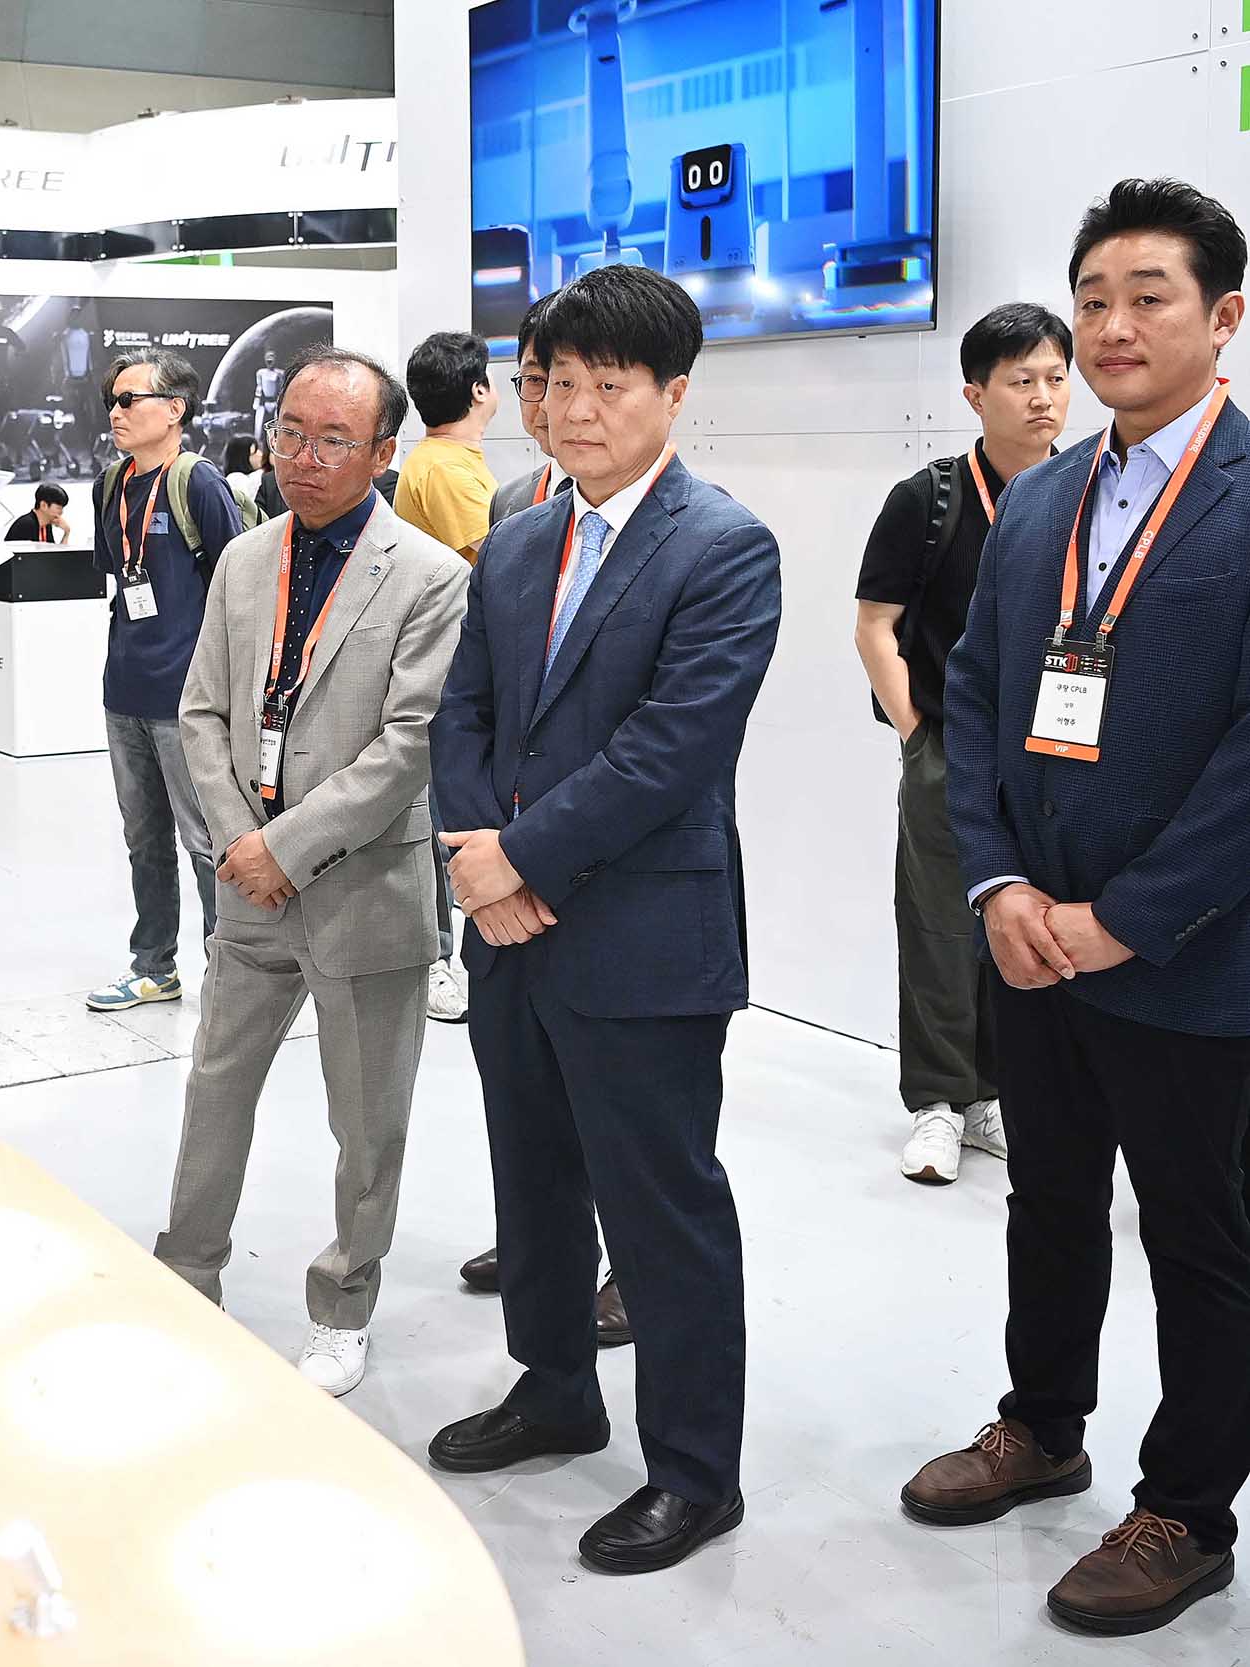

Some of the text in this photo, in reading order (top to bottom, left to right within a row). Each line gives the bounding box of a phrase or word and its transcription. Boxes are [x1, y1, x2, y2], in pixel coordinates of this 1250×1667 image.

[161, 330, 231, 349] UNITREE
[1188, 420, 1211, 453] coupang
[1135, 530, 1154, 559] CPLB
[1045, 655, 1068, 667] STK
[1070, 686, 1088, 694] CPLB
[1054, 744, 1069, 753] VIP
